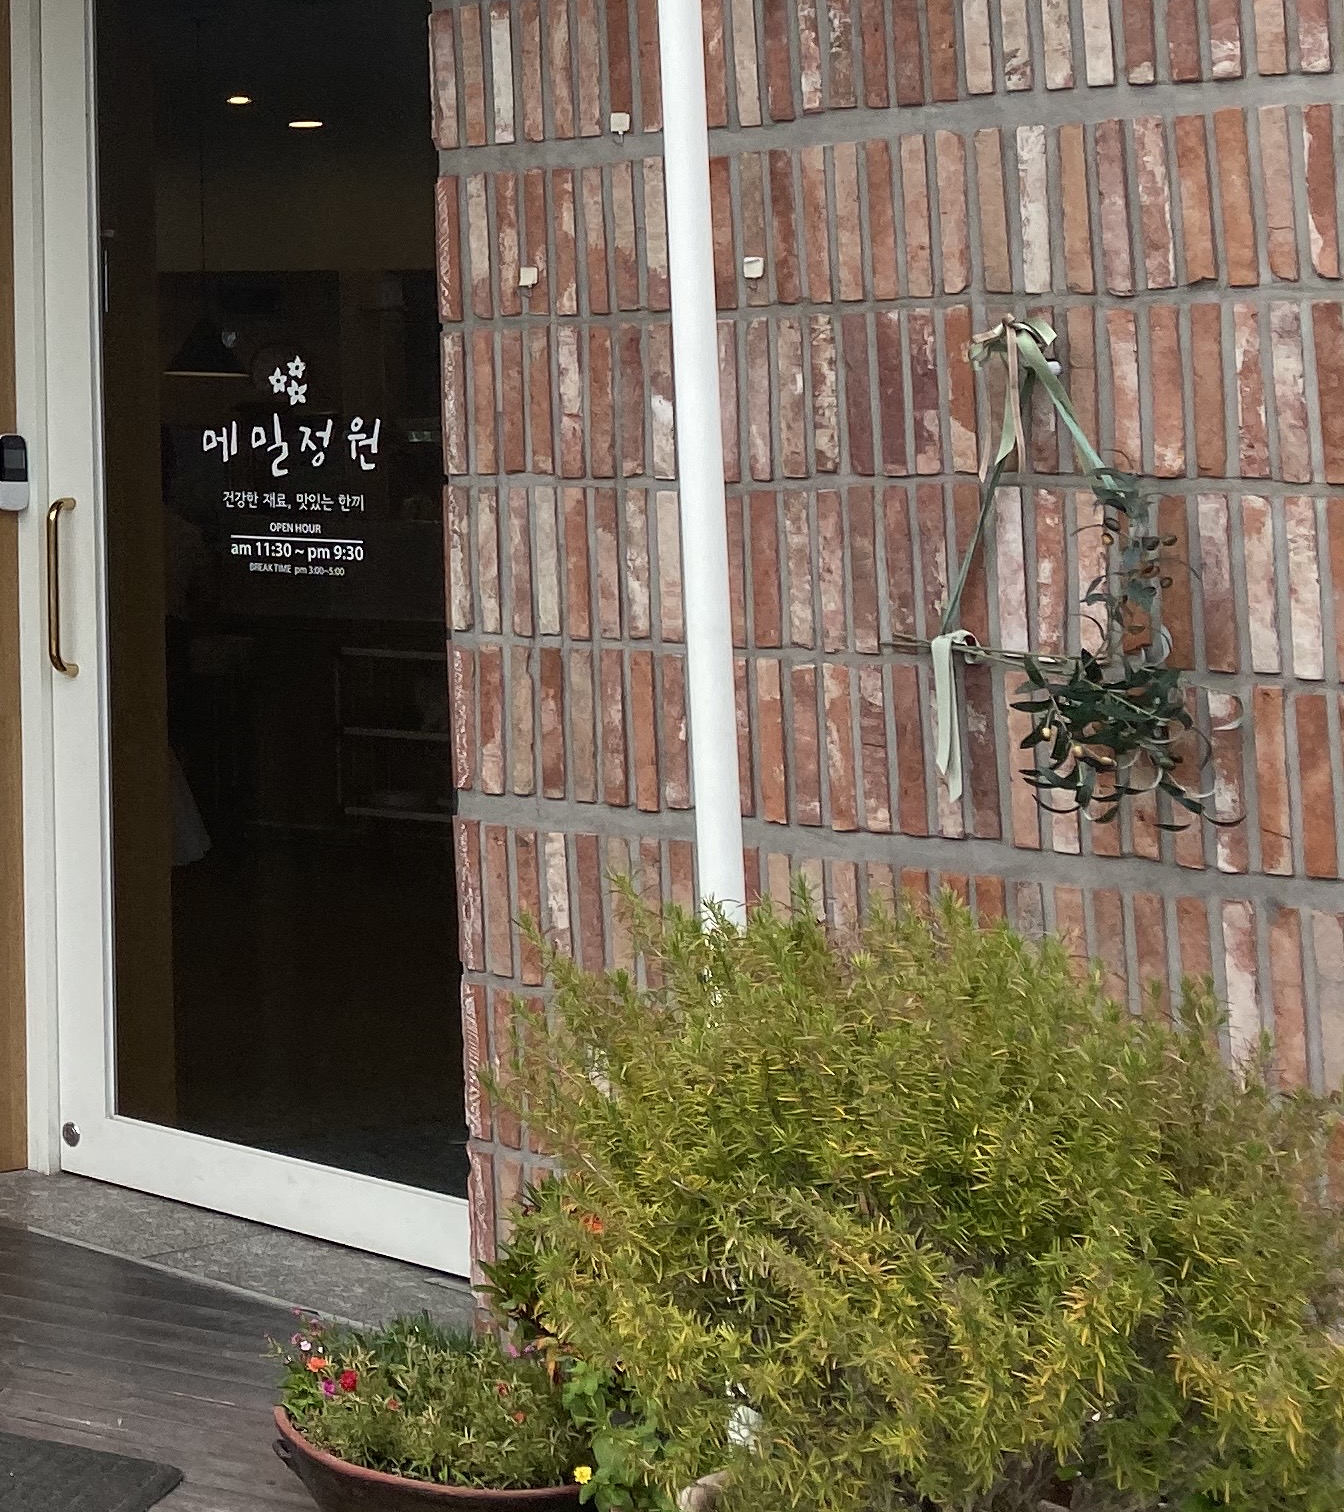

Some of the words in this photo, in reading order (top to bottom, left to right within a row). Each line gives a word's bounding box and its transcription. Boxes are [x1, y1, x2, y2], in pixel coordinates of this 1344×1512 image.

[203, 413, 381, 477] 메밀정원
[223, 491, 259, 509] 건강한
[263, 492, 291, 510] 재료,
[296, 493, 334, 511] 맛있는
[338, 494, 365, 512] 한끼
[270, 522, 294, 533] OPEN
[295, 523, 321, 534] HOUR
[231, 543, 252, 556] am
[255, 542, 292, 557] 11:30
[307, 546, 330, 562] pm
[333, 545, 364, 561] 9:30
[249, 562, 273, 572] BREAK
[274, 563, 292, 574] TIME
[294, 565, 307, 575] pm
